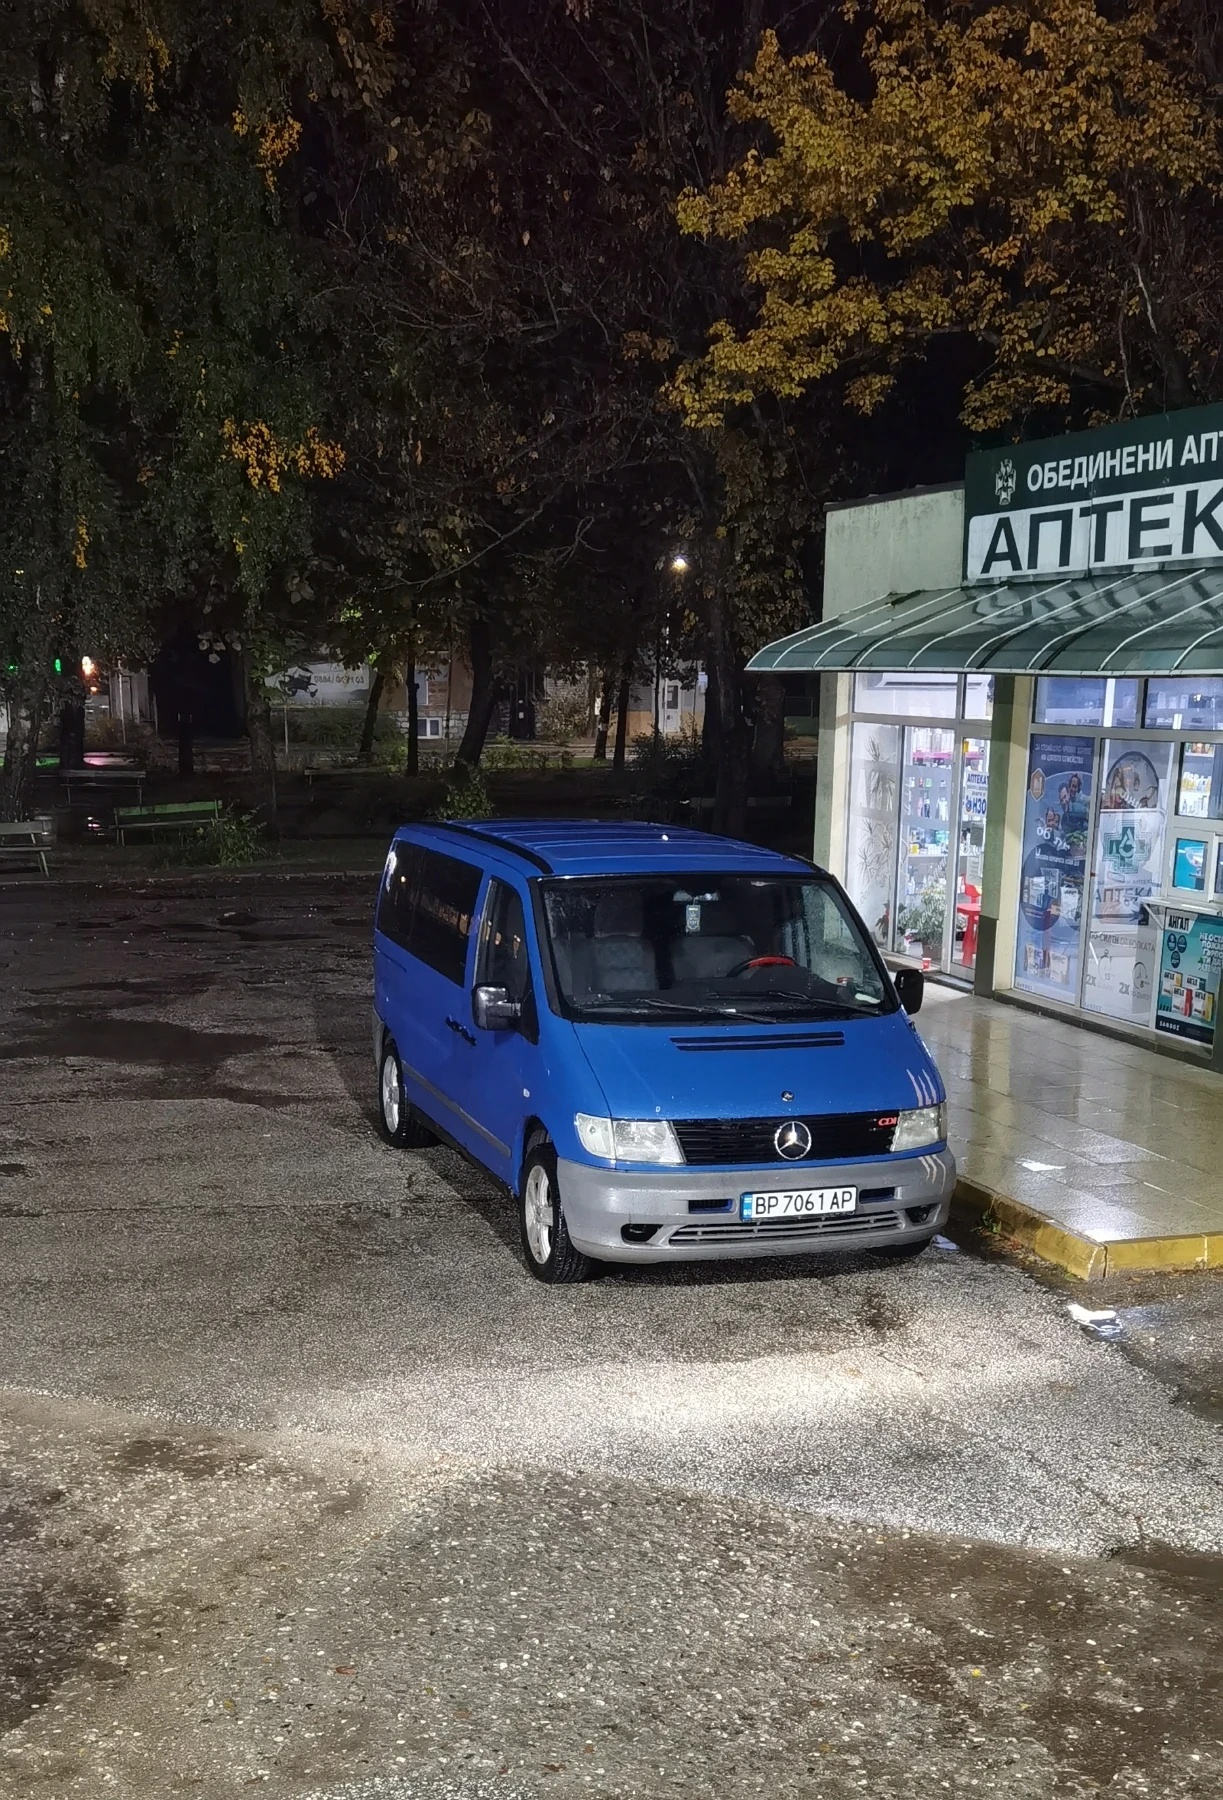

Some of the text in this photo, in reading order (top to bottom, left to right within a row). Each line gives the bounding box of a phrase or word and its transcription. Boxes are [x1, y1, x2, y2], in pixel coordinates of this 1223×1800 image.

[1027, 431, 1223, 492] ОБЕДИНЕНИ АП
[980, 486, 1223, 574] АПТЕК
[1168, 914, 1190, 931] АНГАЛ
[878, 1117, 898, 1126] CDI
